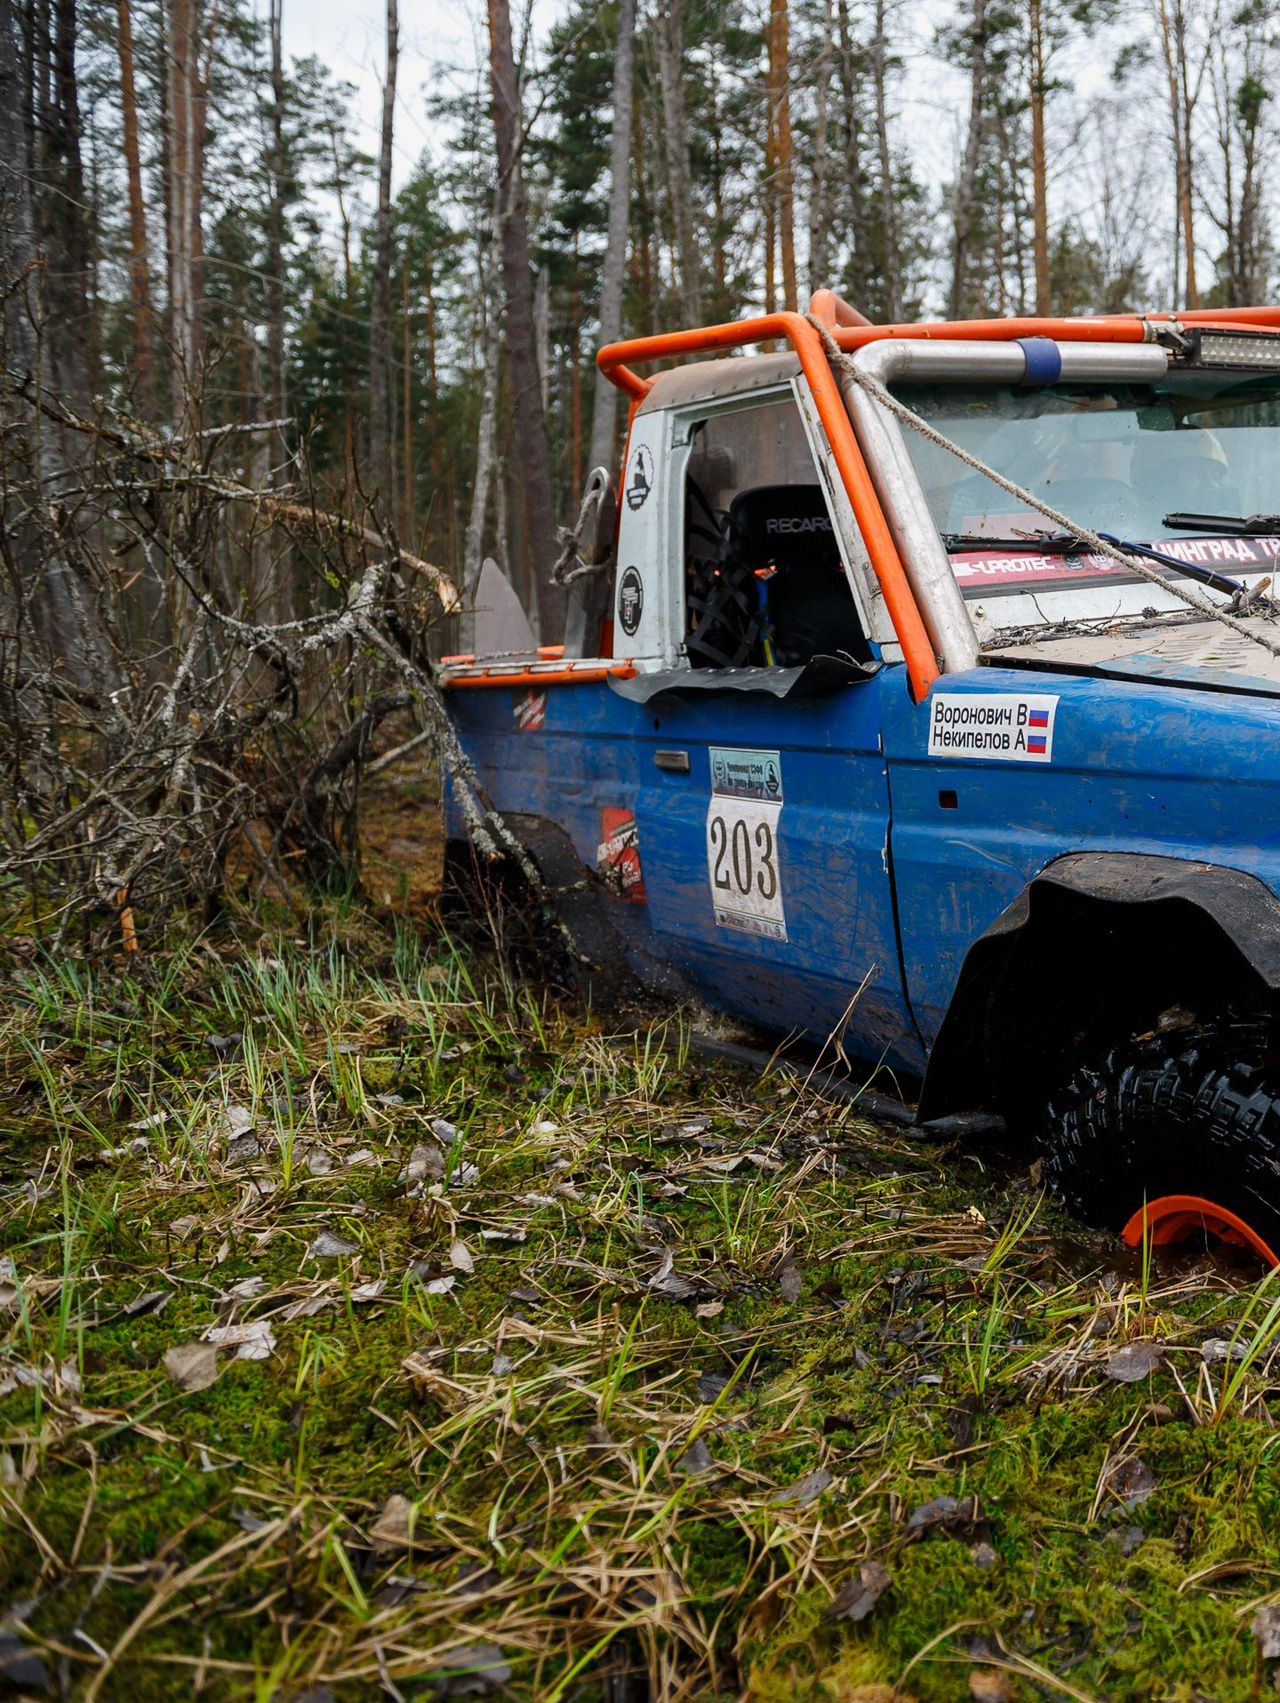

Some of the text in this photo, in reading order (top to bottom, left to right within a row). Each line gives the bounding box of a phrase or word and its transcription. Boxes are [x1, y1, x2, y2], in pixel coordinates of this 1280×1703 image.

[970, 556, 1056, 574] SUPROTEC
[934, 702, 1028, 729] Воронович В
[932, 725, 1026, 751] Некипелов А
[710, 816, 777, 901] 203
